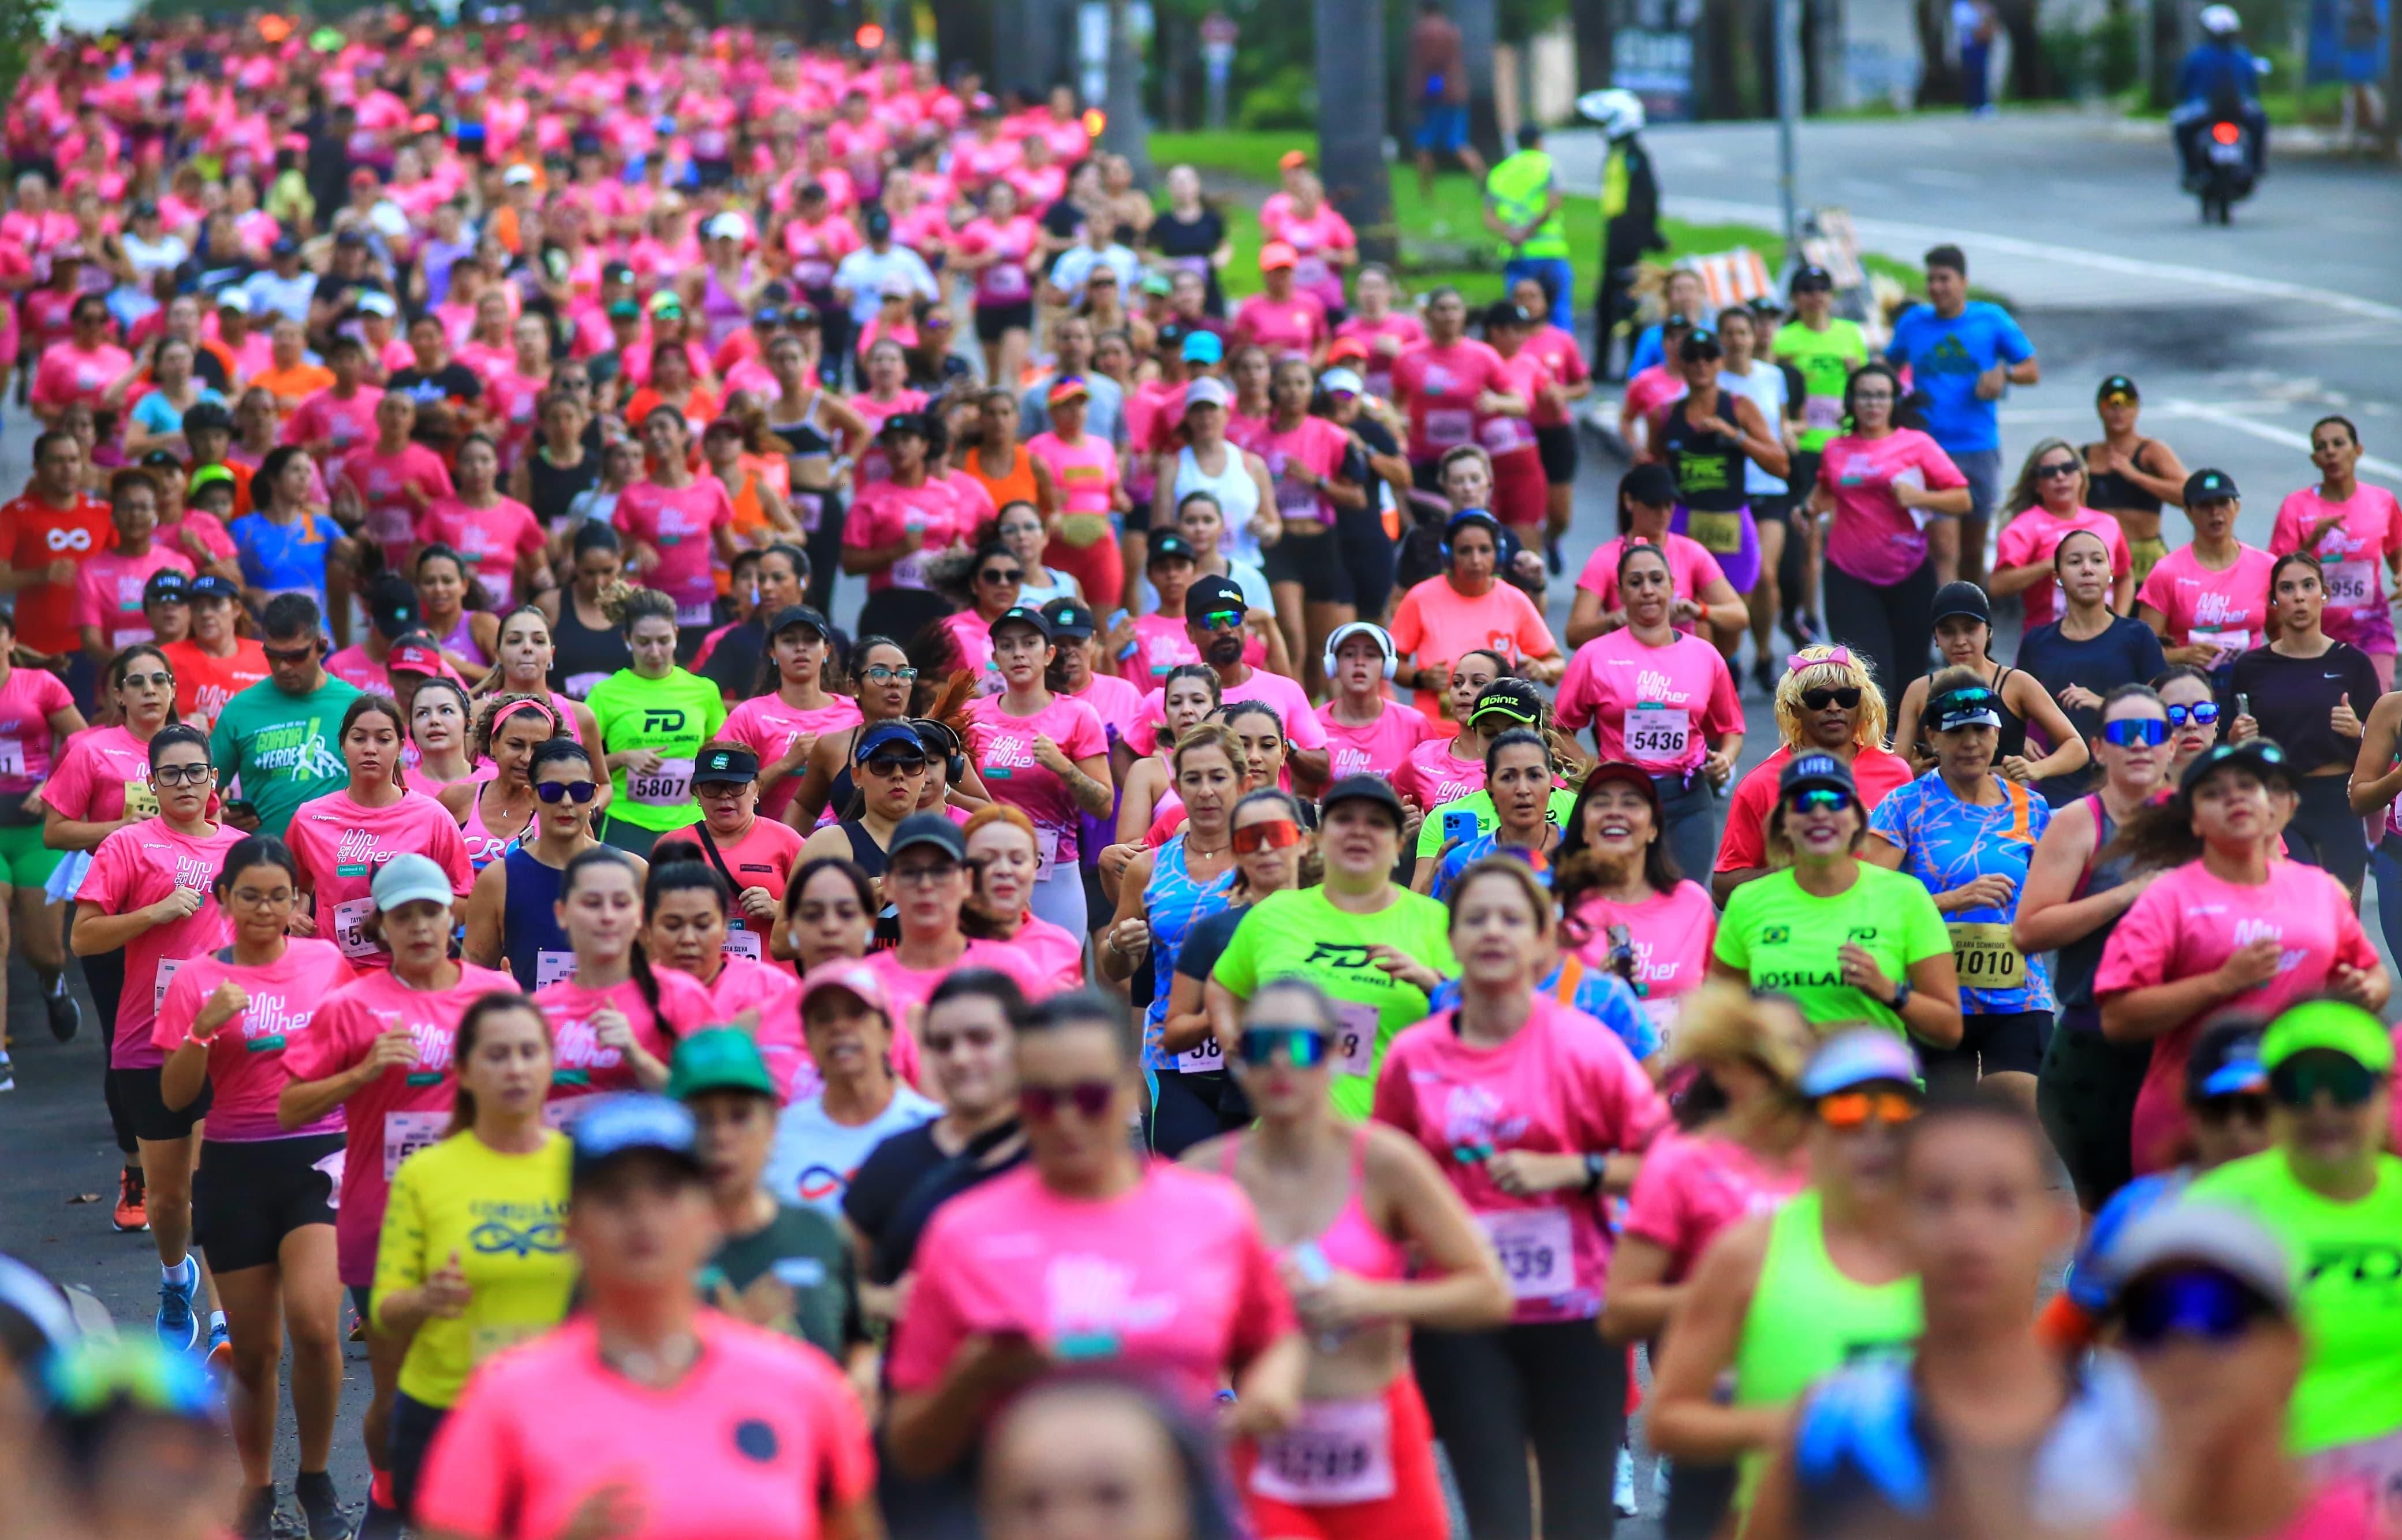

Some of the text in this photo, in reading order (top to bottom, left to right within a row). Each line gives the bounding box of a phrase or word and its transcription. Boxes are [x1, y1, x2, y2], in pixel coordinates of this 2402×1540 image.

[2330, 580, 2364, 598] 956
[643, 709, 685, 733] FD
[1634, 732, 1684, 751] 5436
[636, 778, 685, 797] 5807
[1955, 950, 2014, 975] 1010
